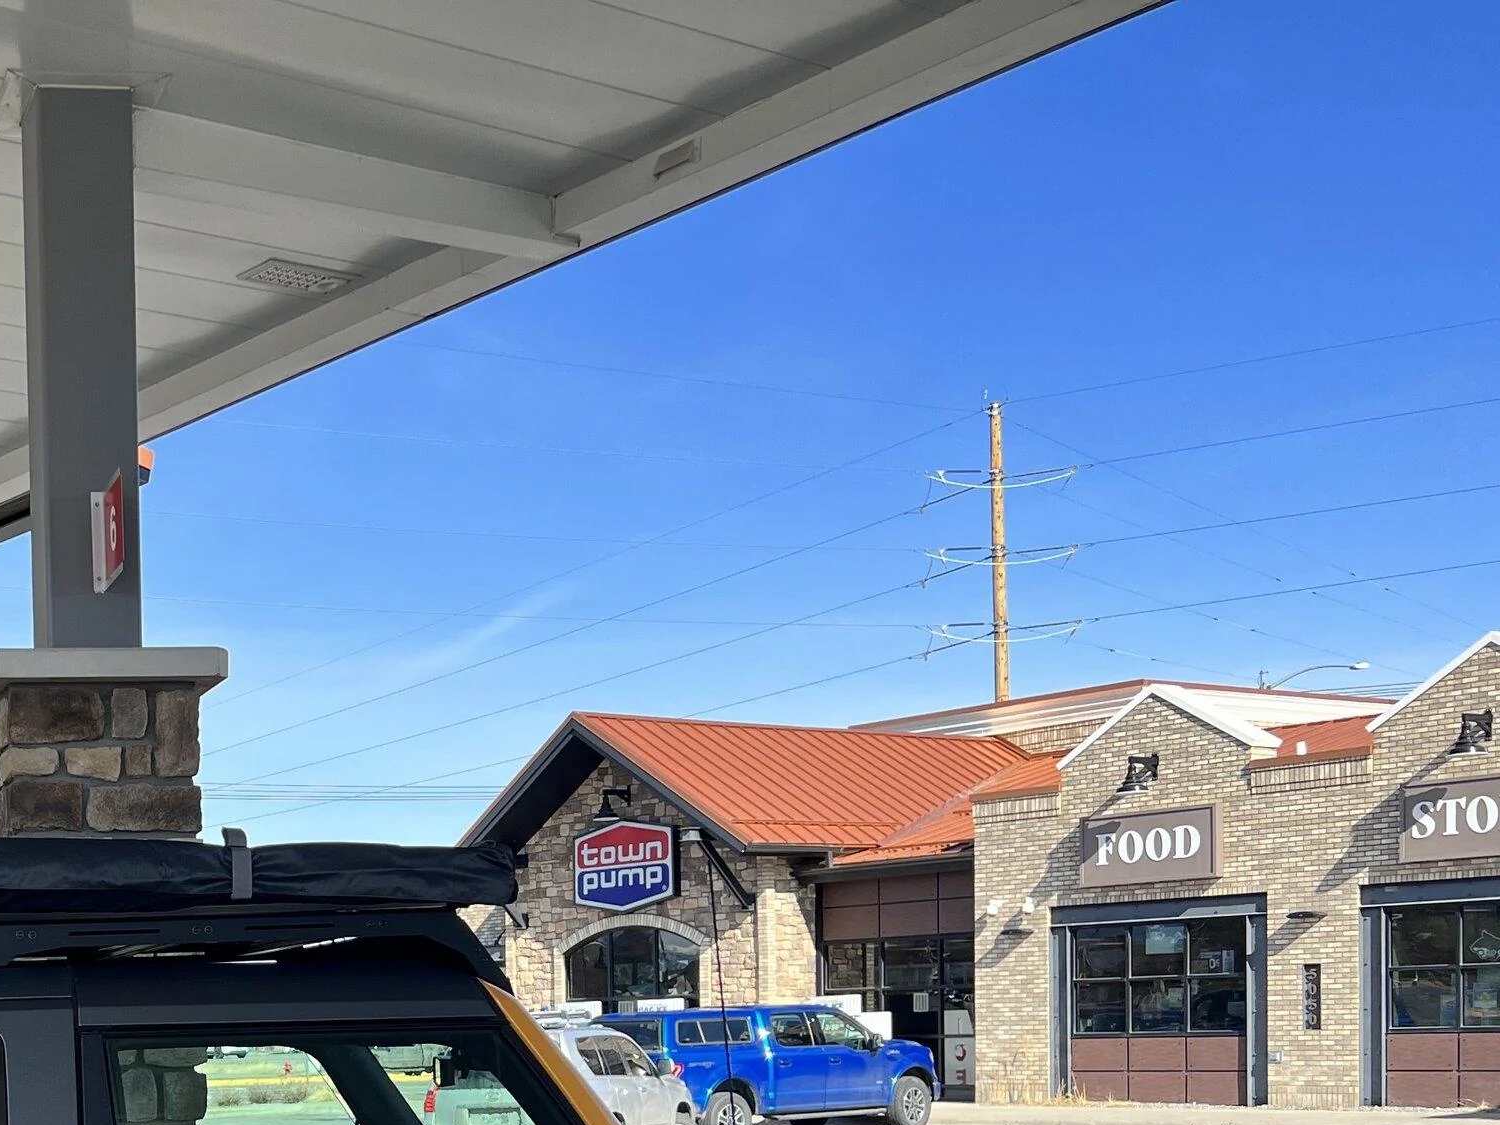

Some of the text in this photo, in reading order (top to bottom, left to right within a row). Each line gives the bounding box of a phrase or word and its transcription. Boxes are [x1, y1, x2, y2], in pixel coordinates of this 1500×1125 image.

[109, 505, 117, 551] 6
[1411, 795, 1500, 839] STO
[581, 841, 662, 866] town
[1095, 825, 1201, 866] FOOD
[583, 866, 663, 895] pump
[1209, 958, 1220, 970] 0¢
